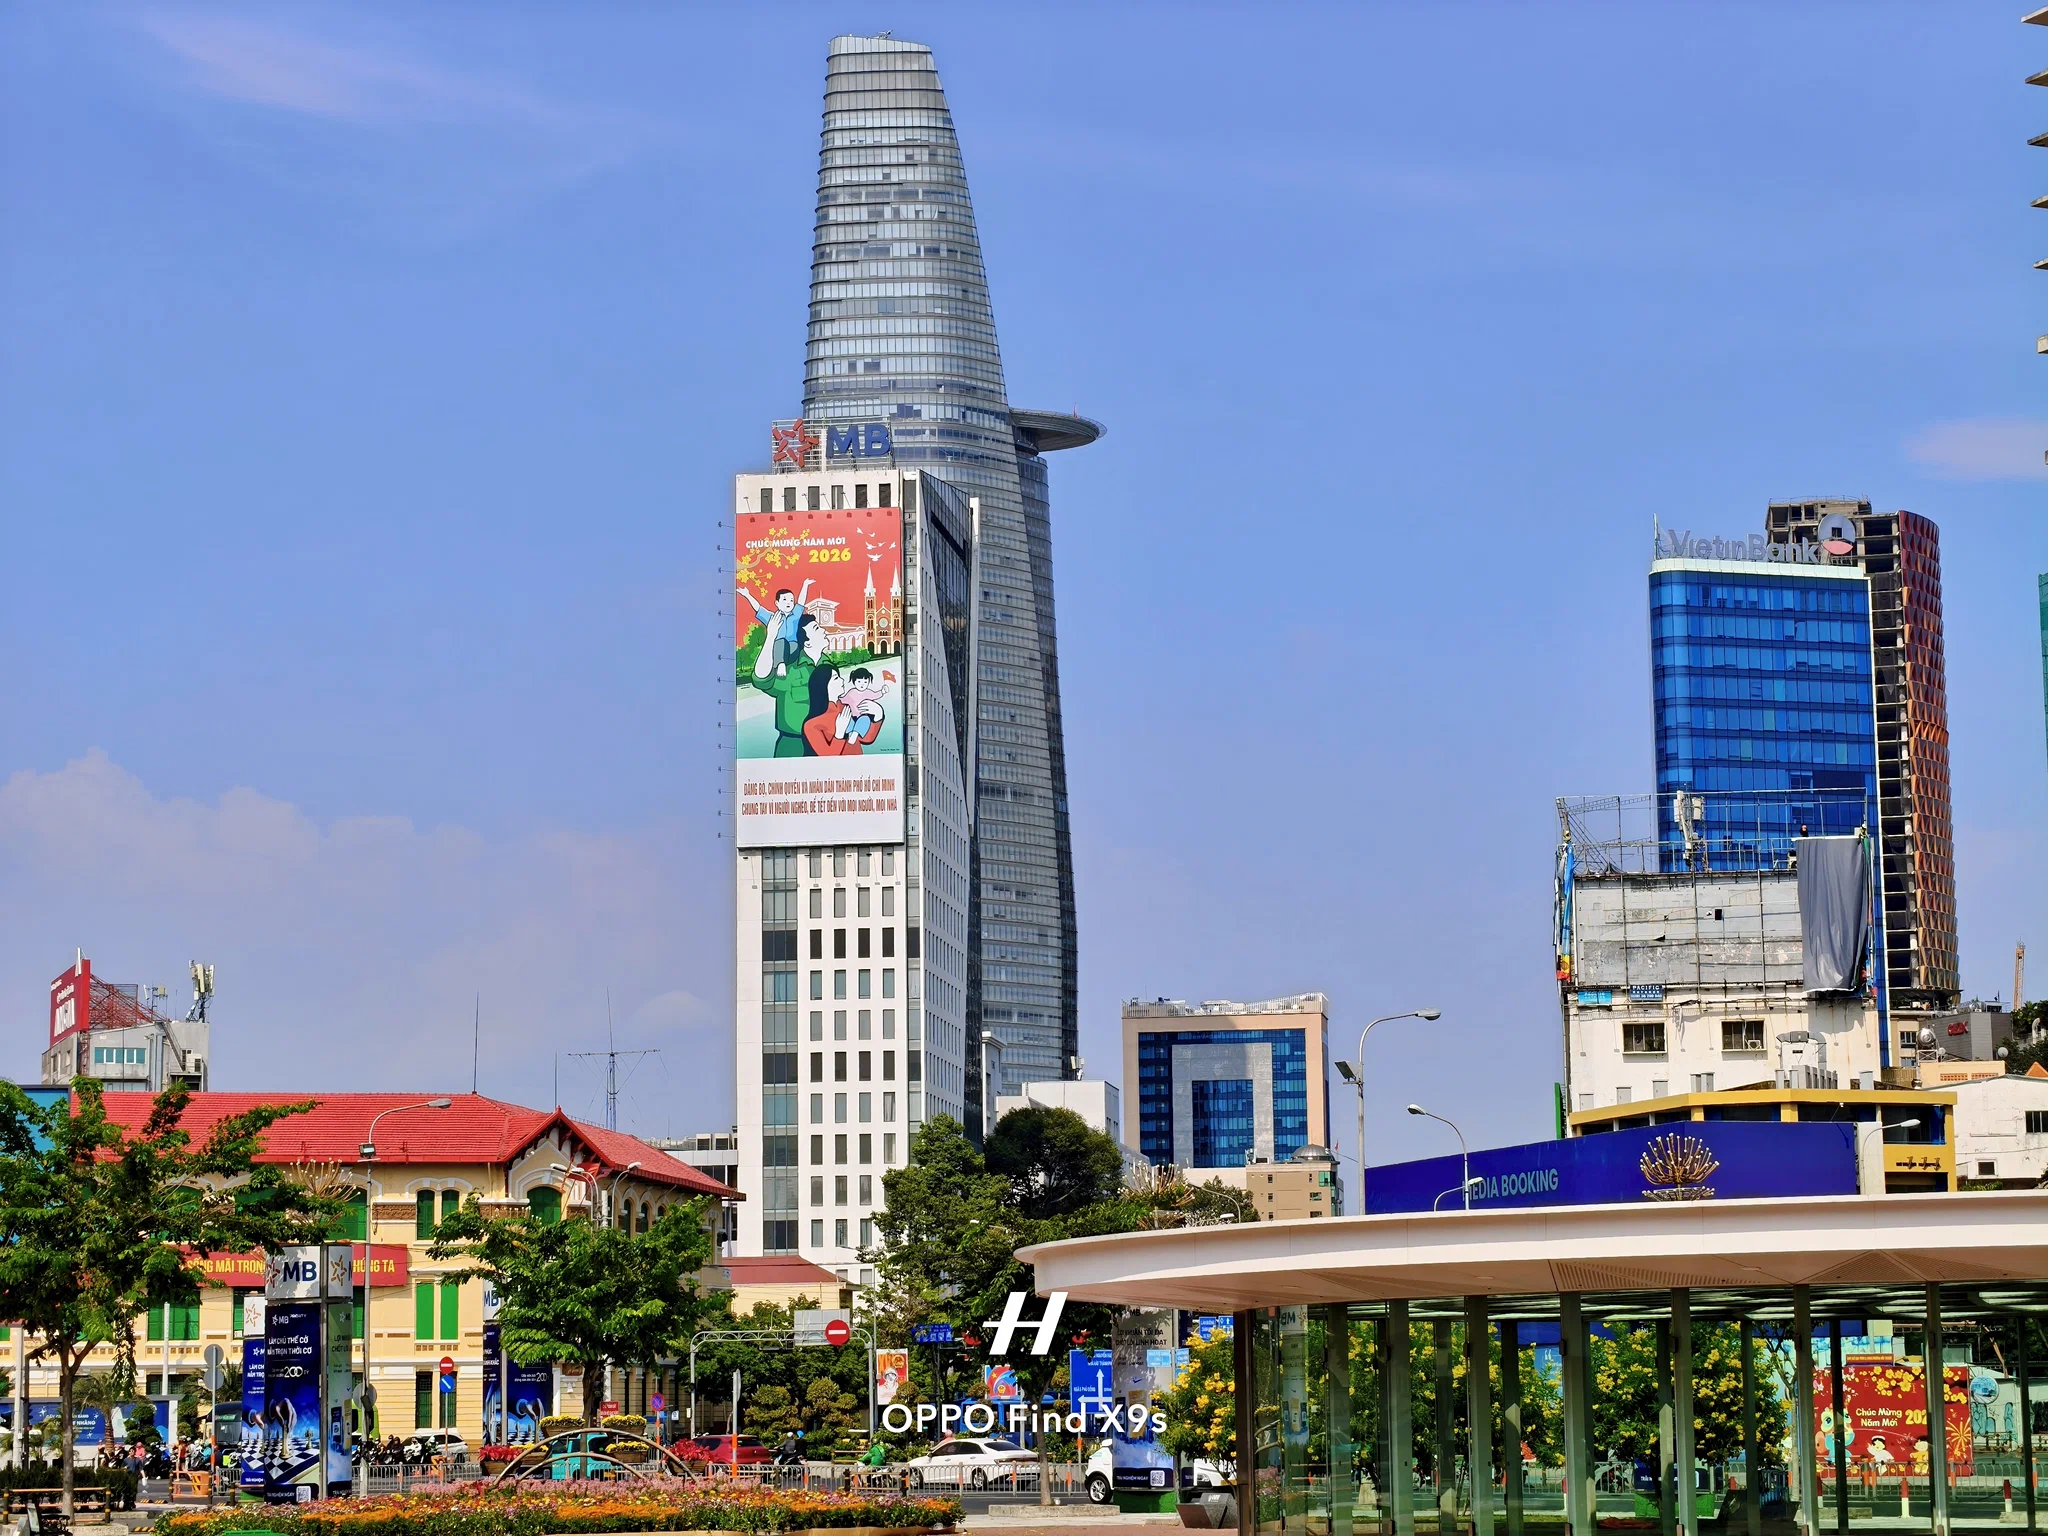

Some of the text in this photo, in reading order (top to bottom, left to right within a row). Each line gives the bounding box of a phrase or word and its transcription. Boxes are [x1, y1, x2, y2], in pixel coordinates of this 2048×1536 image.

[826, 424, 891, 459] MB
[745, 536, 846, 549] CHÚC MỪNG NĂM MỚI
[1668, 529, 1820, 564] VietinBank
[808, 547, 852, 563] 2026
[1501, 1168, 1559, 1197] BOOKING
[215, 1257, 235, 1273] MÃI
[237, 1260, 266, 1273] TRON
[382, 1260, 395, 1273] TA
[282, 1261, 317, 1283] MB
[1856, 1408, 1877, 1416] Chúc
[1878, 1408, 1902, 1419] Mừng
[1860, 1418, 1898, 1427] Năm Mới
